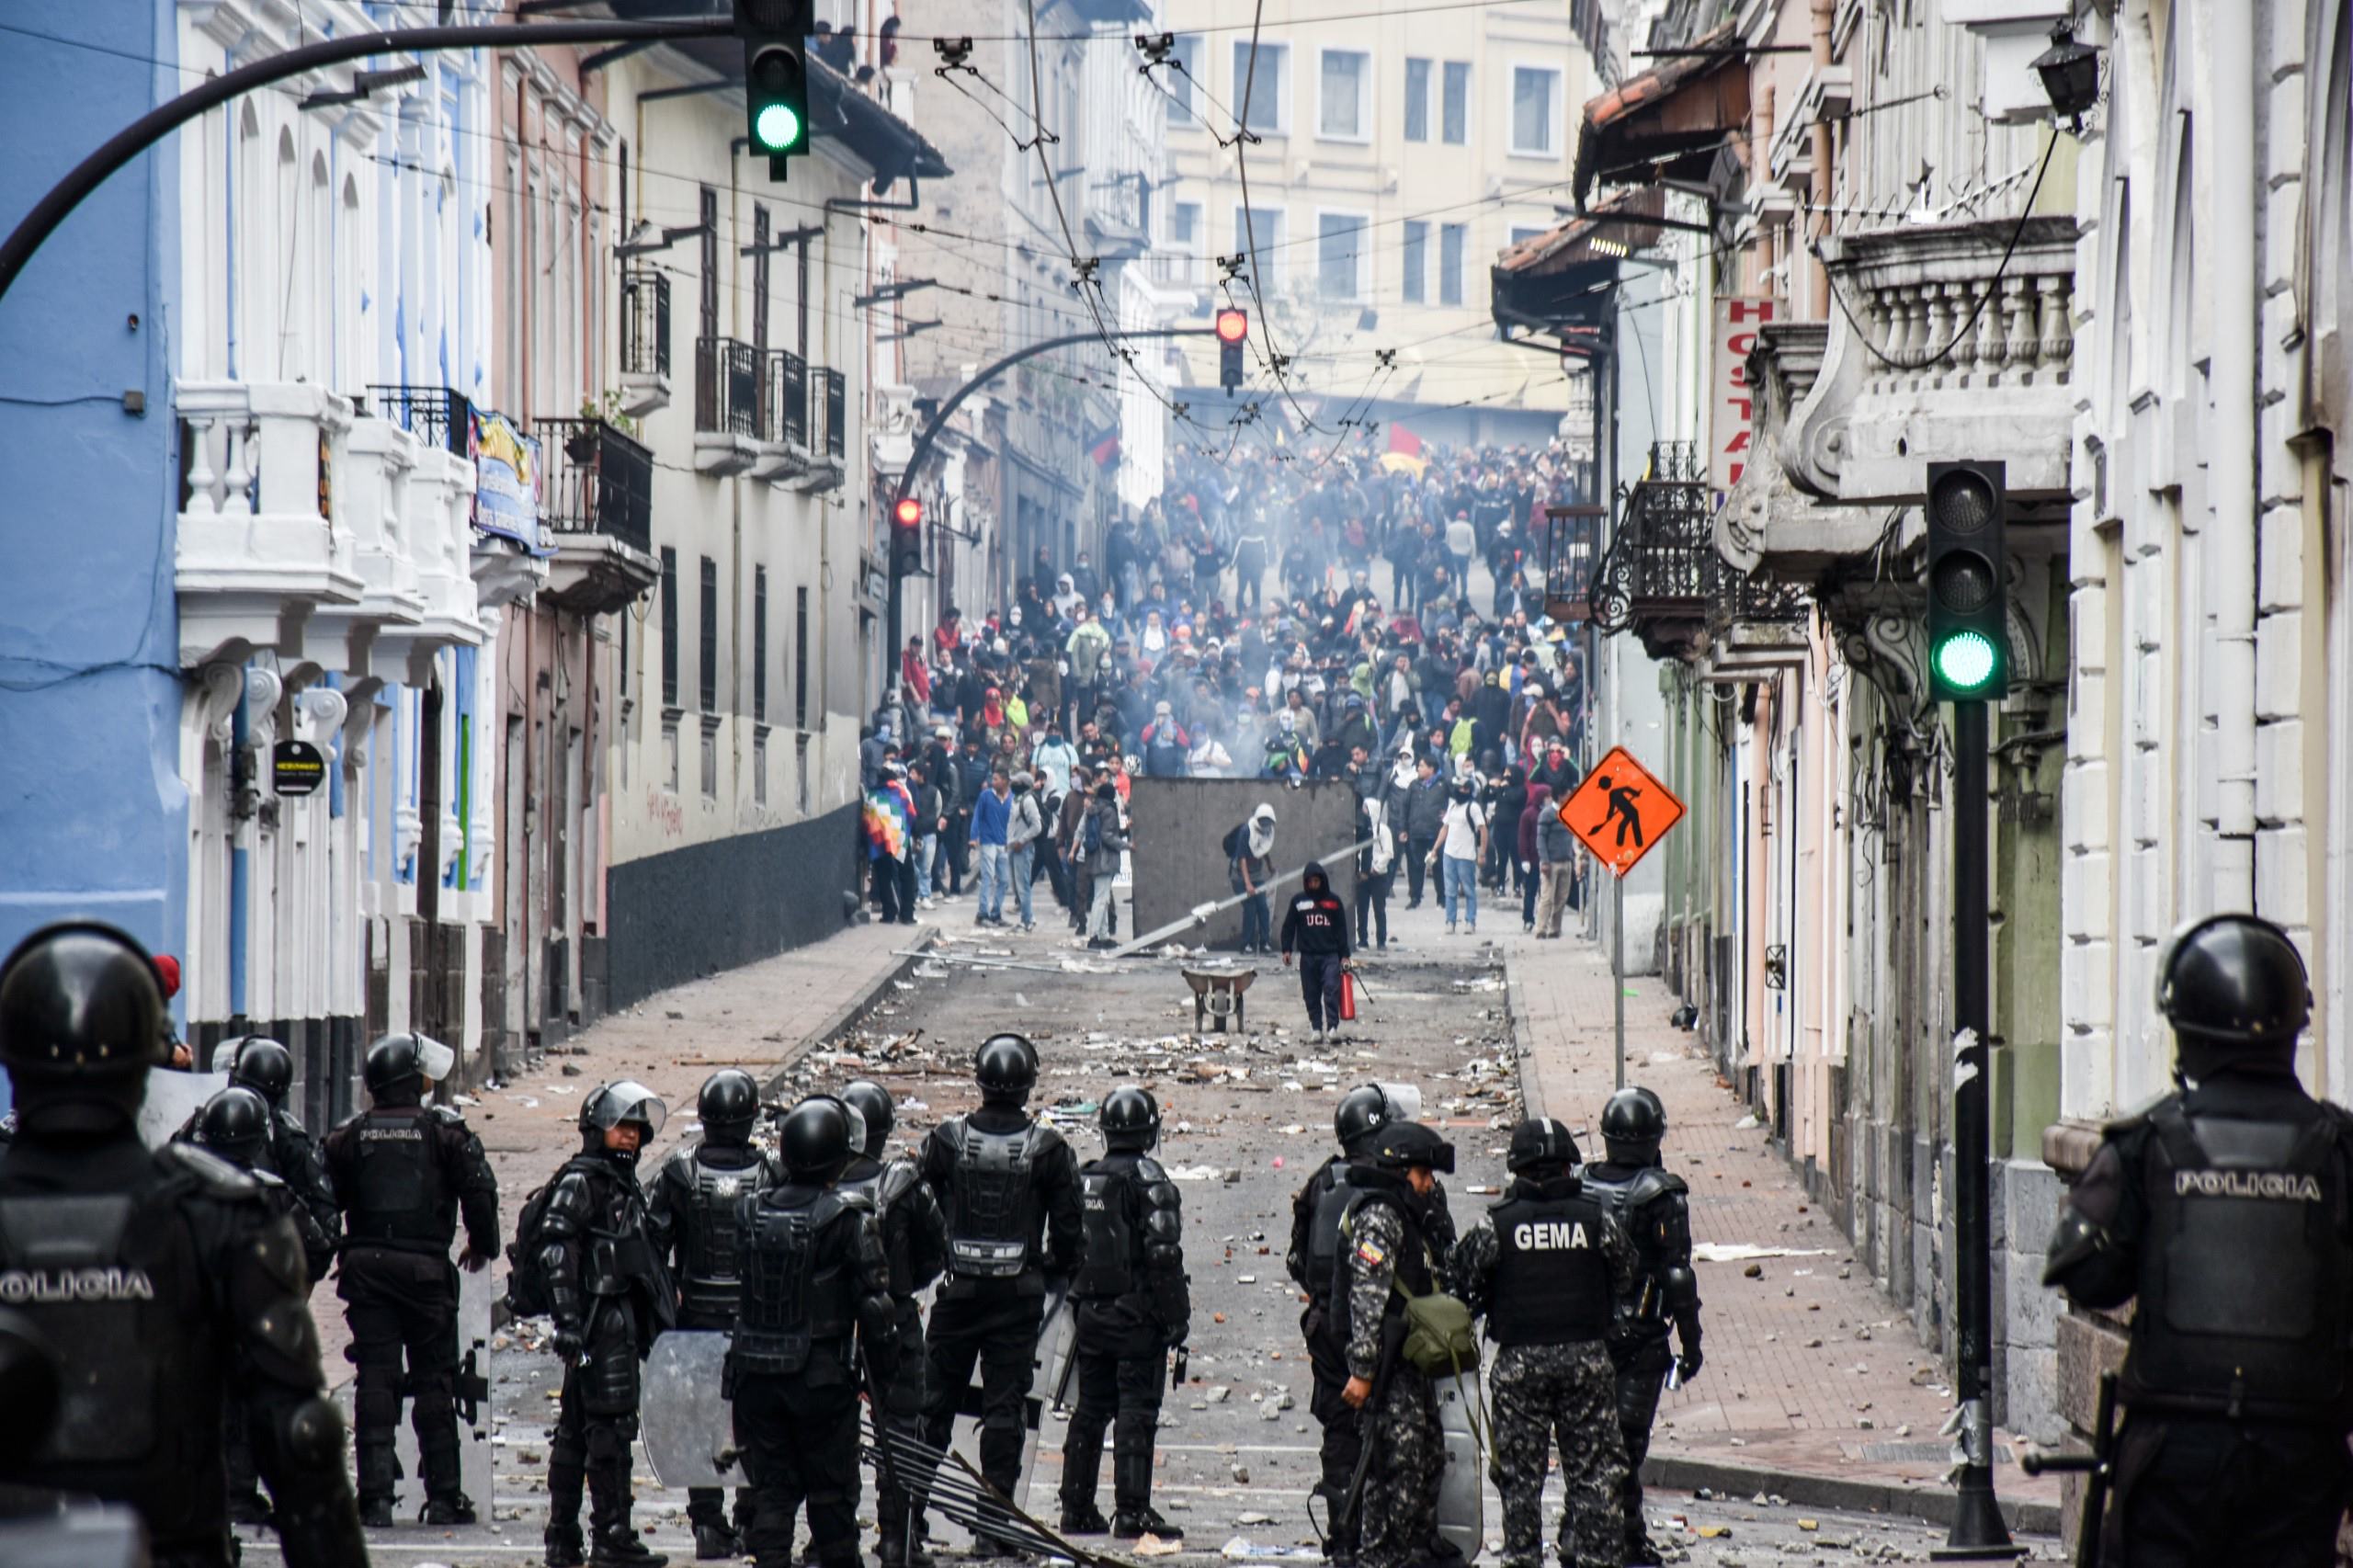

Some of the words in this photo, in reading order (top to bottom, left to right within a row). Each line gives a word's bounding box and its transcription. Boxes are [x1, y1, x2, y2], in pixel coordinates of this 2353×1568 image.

[359, 1128, 422, 1141] POLICIA
[2175, 1169, 2321, 1201] POLICIA
[1514, 1221, 1588, 1251] GEMA
[0, 1267, 154, 1303] OLICIA
